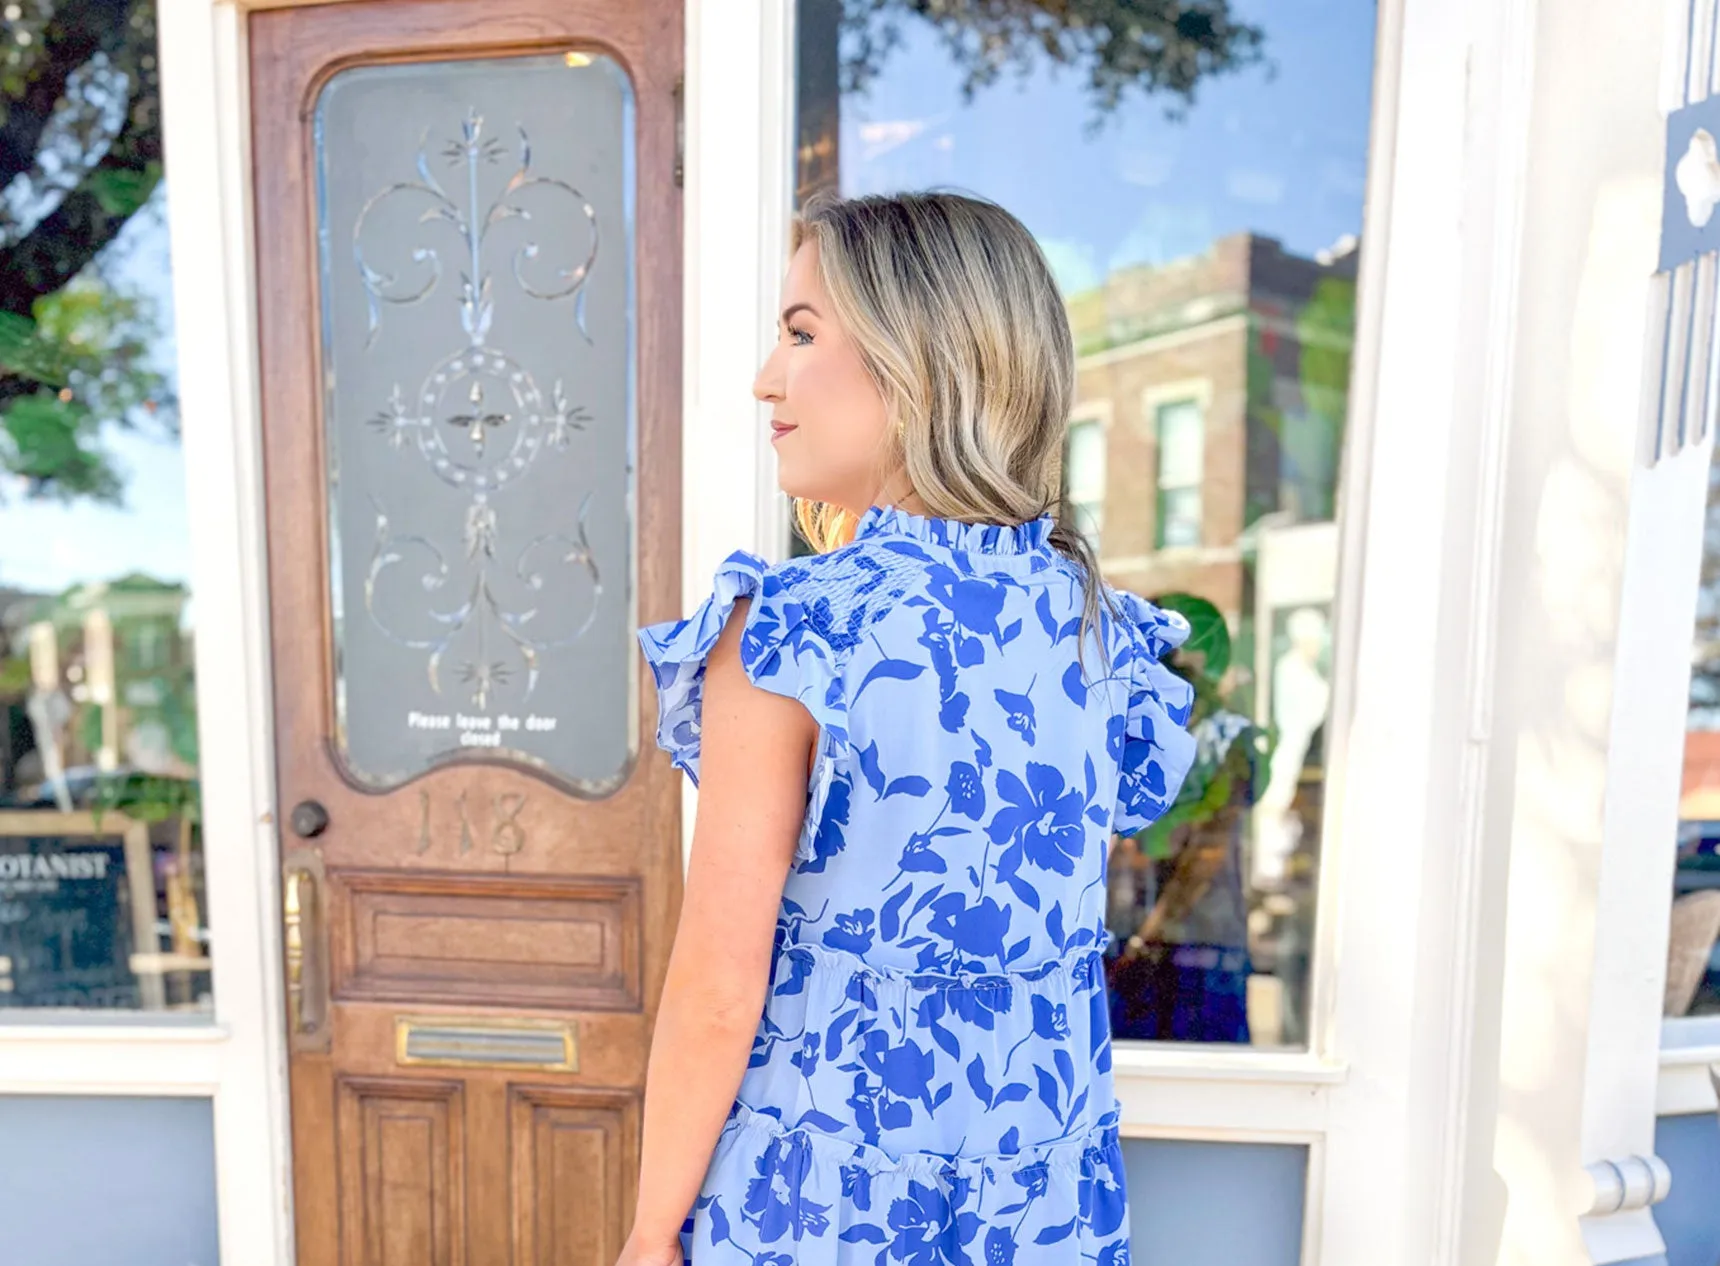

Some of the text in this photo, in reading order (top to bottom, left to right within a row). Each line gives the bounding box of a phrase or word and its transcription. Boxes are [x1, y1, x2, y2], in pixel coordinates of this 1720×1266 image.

[408, 711, 556, 731] Please leave the door
[460, 730, 501, 746] closed
[416, 788, 526, 857] 118
